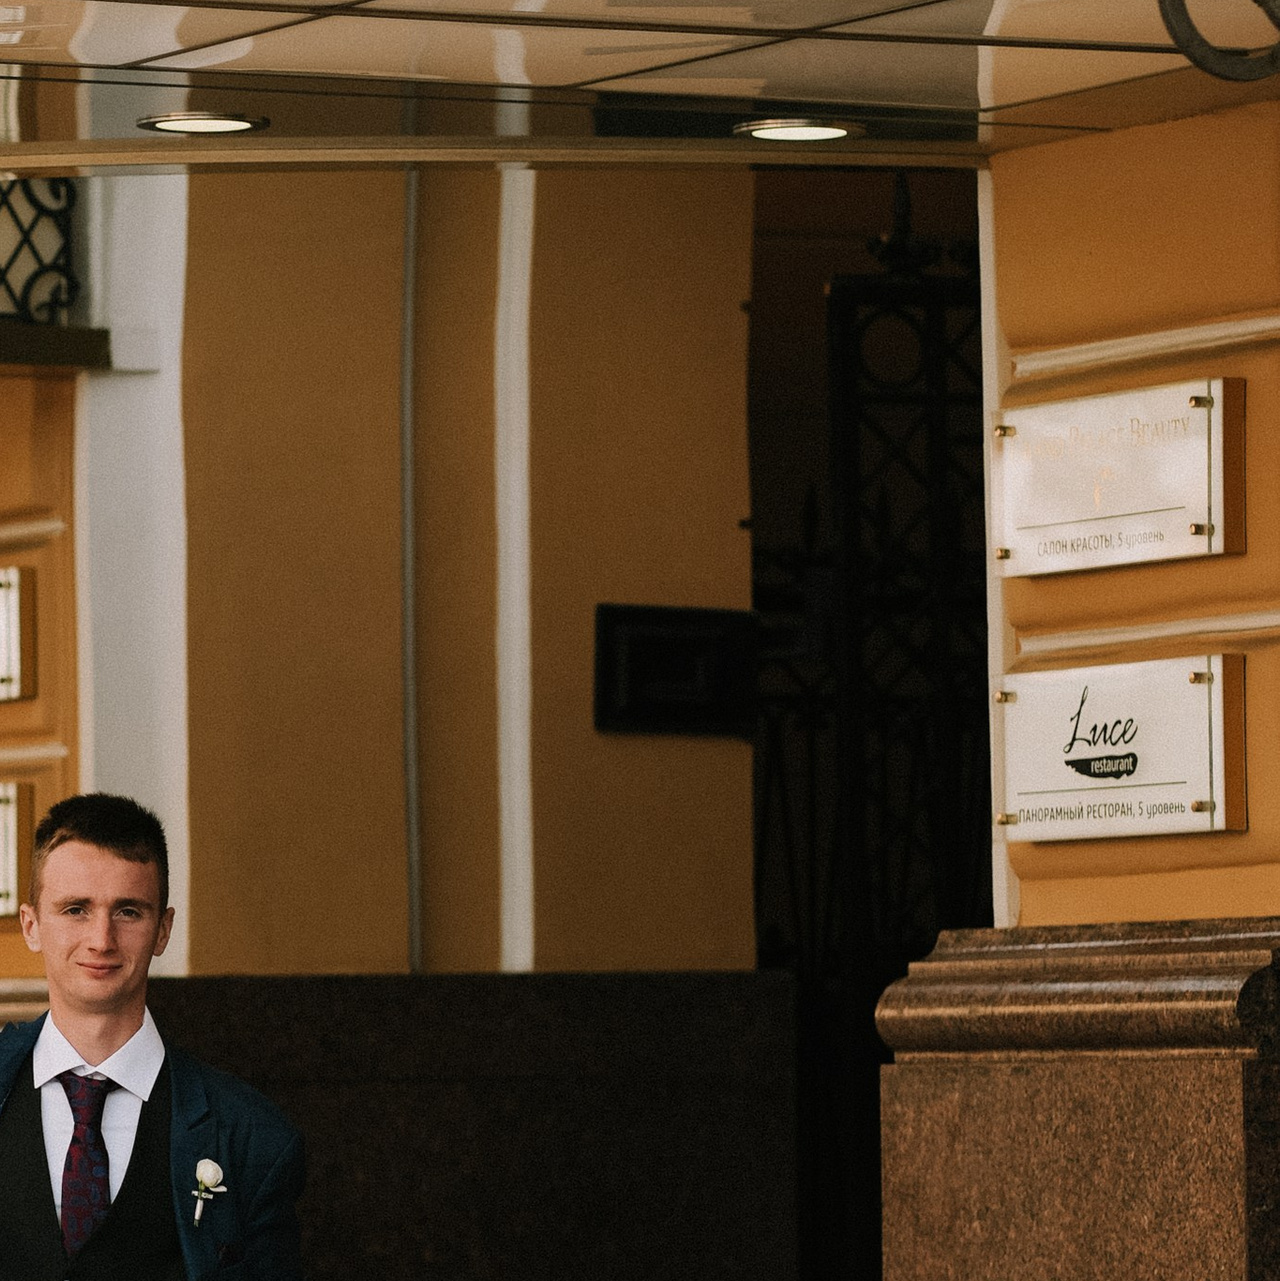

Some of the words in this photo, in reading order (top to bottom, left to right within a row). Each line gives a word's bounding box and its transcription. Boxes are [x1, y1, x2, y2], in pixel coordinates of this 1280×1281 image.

[1037, 540, 1068, 557] САЛОН
[1070, 533, 1115, 554] КРАСОТЫ,
[1117, 531, 1123, 547] 5
[1125, 531, 1165, 550] уровень
[1063, 685, 1139, 754] Luce
[1090, 755, 1134, 773] restaurant
[1018, 801, 1084, 823] ПАНОРАМНЫЙ
[1086, 801, 1136, 820] РЕСТОРАН,
[1138, 800, 1144, 817] 5
[1146, 801, 1186, 820] уровень
